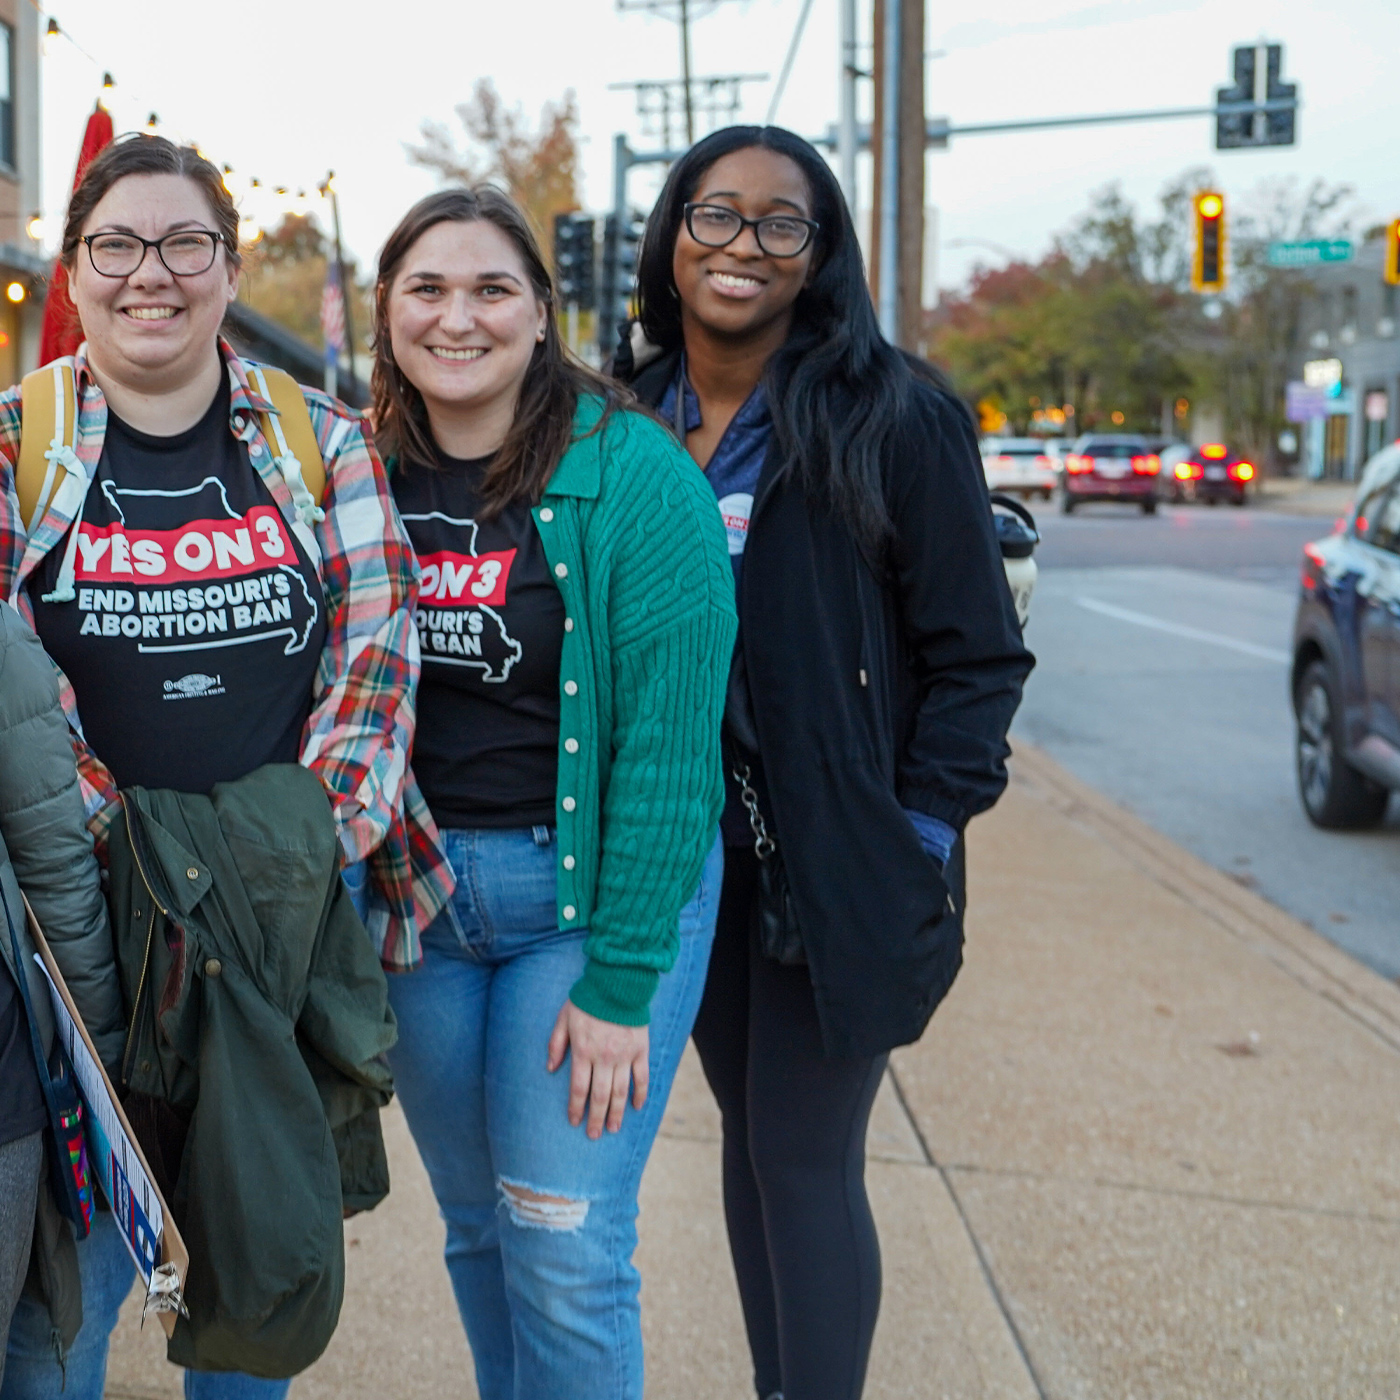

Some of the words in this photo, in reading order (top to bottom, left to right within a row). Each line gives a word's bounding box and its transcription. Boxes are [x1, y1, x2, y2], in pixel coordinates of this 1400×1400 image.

[77, 533, 167, 577] YES
[173, 528, 256, 572] ON
[255, 515, 286, 558] 3
[78, 588, 135, 612] END
[138, 573, 292, 614] MISSOURI'S
[419, 561, 474, 600] ON
[471, 560, 502, 598] 3
[80, 608, 228, 638] ABORTION
[232, 597, 292, 629] BAN
[417, 609, 484, 634] OURI'S
[432, 632, 482, 656] BAN
